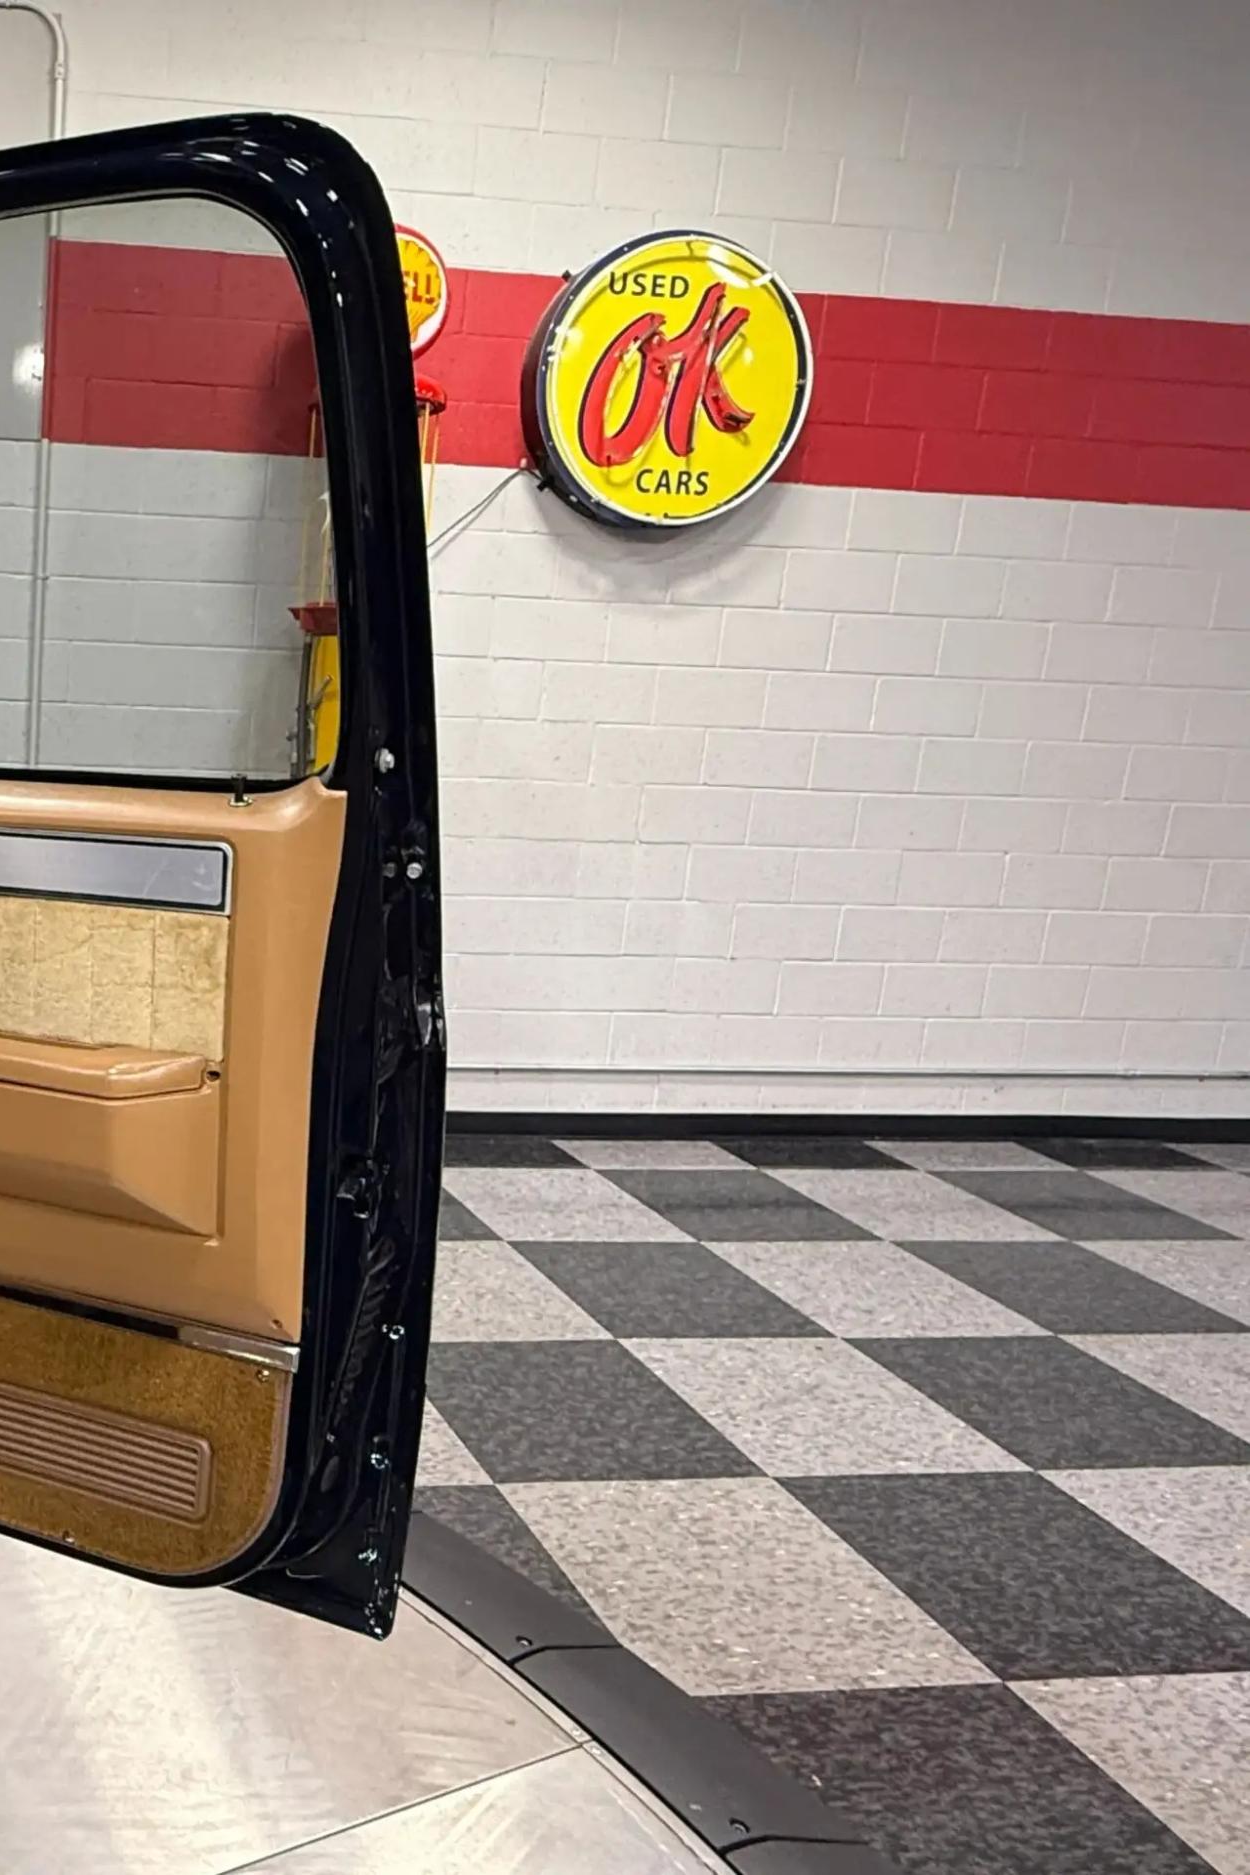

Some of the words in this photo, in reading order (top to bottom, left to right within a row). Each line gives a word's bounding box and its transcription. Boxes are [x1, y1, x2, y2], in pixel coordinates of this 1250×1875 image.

[608, 270, 690, 299] USED
[577, 281, 755, 468] OK
[636, 468, 710, 498] CARS
